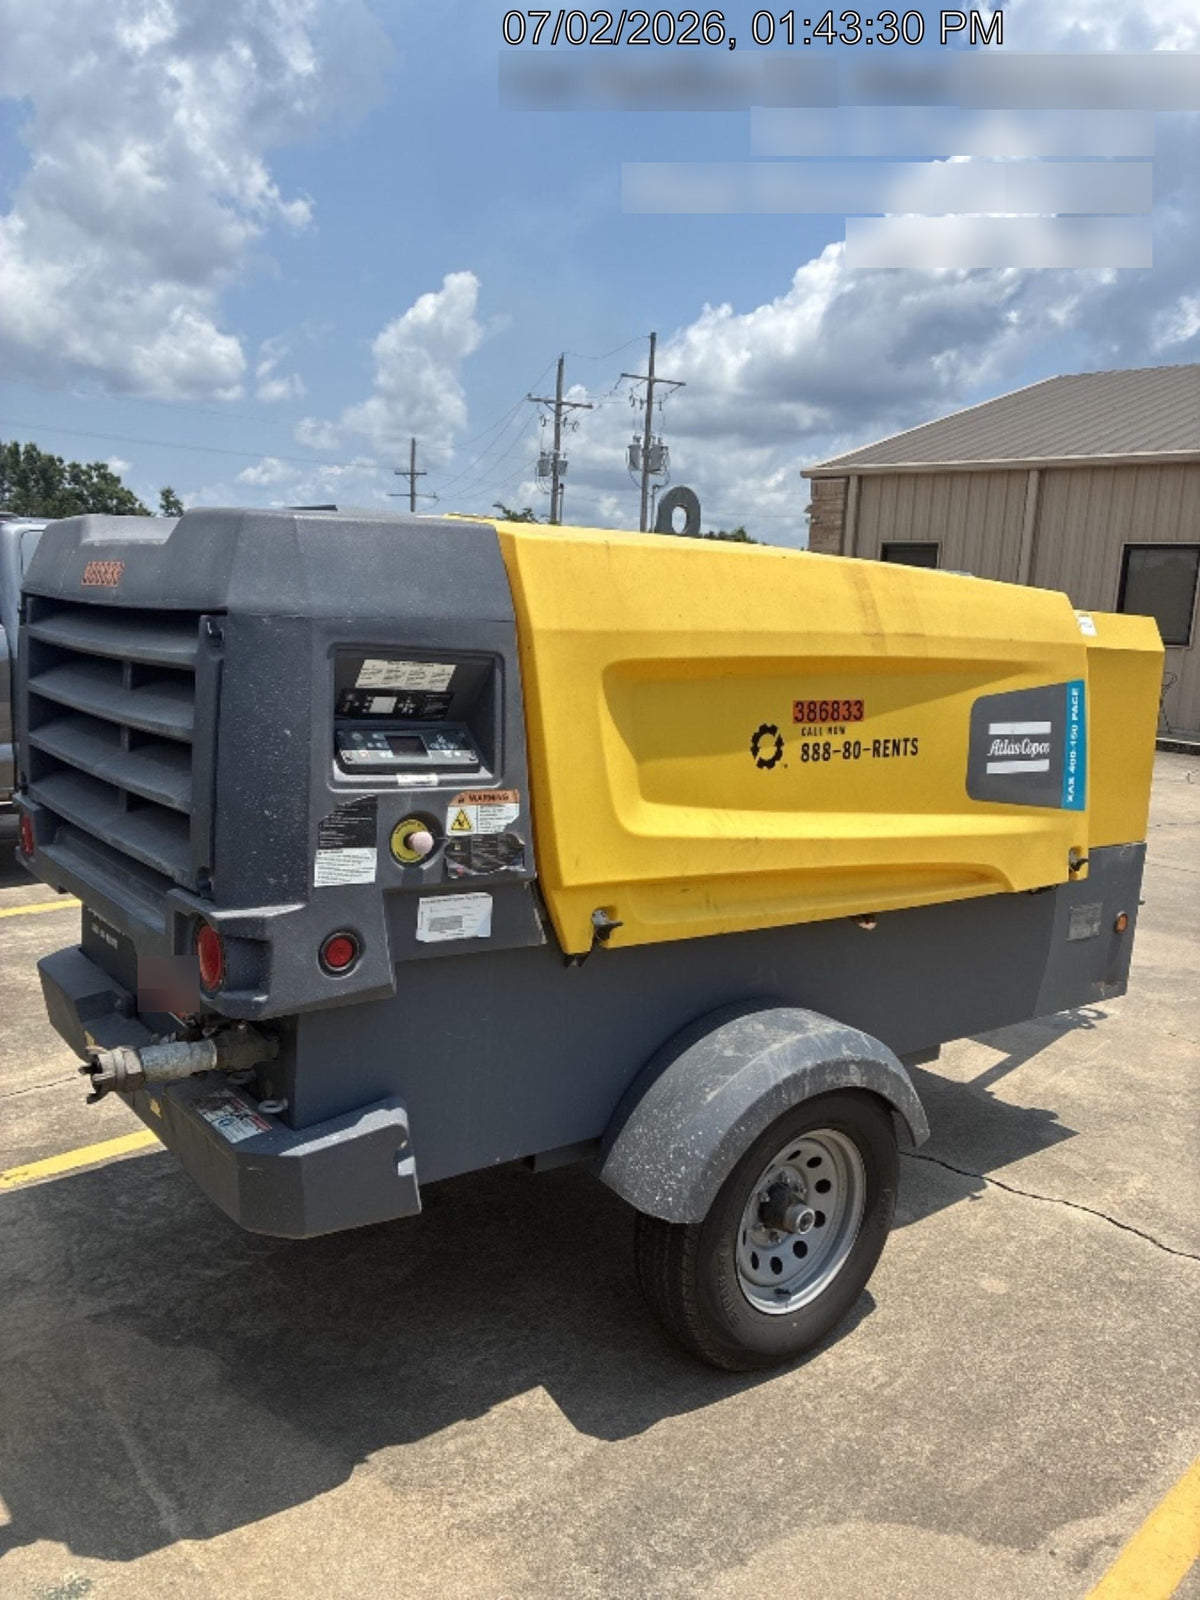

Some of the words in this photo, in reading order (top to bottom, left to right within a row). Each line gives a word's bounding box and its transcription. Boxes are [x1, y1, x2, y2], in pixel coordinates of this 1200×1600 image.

[794, 700, 864, 722] 386833
[801, 727, 823, 737] CALL
[801, 737, 919, 763] 888-80-RENTS
[986, 738, 1021, 756] Atlas
